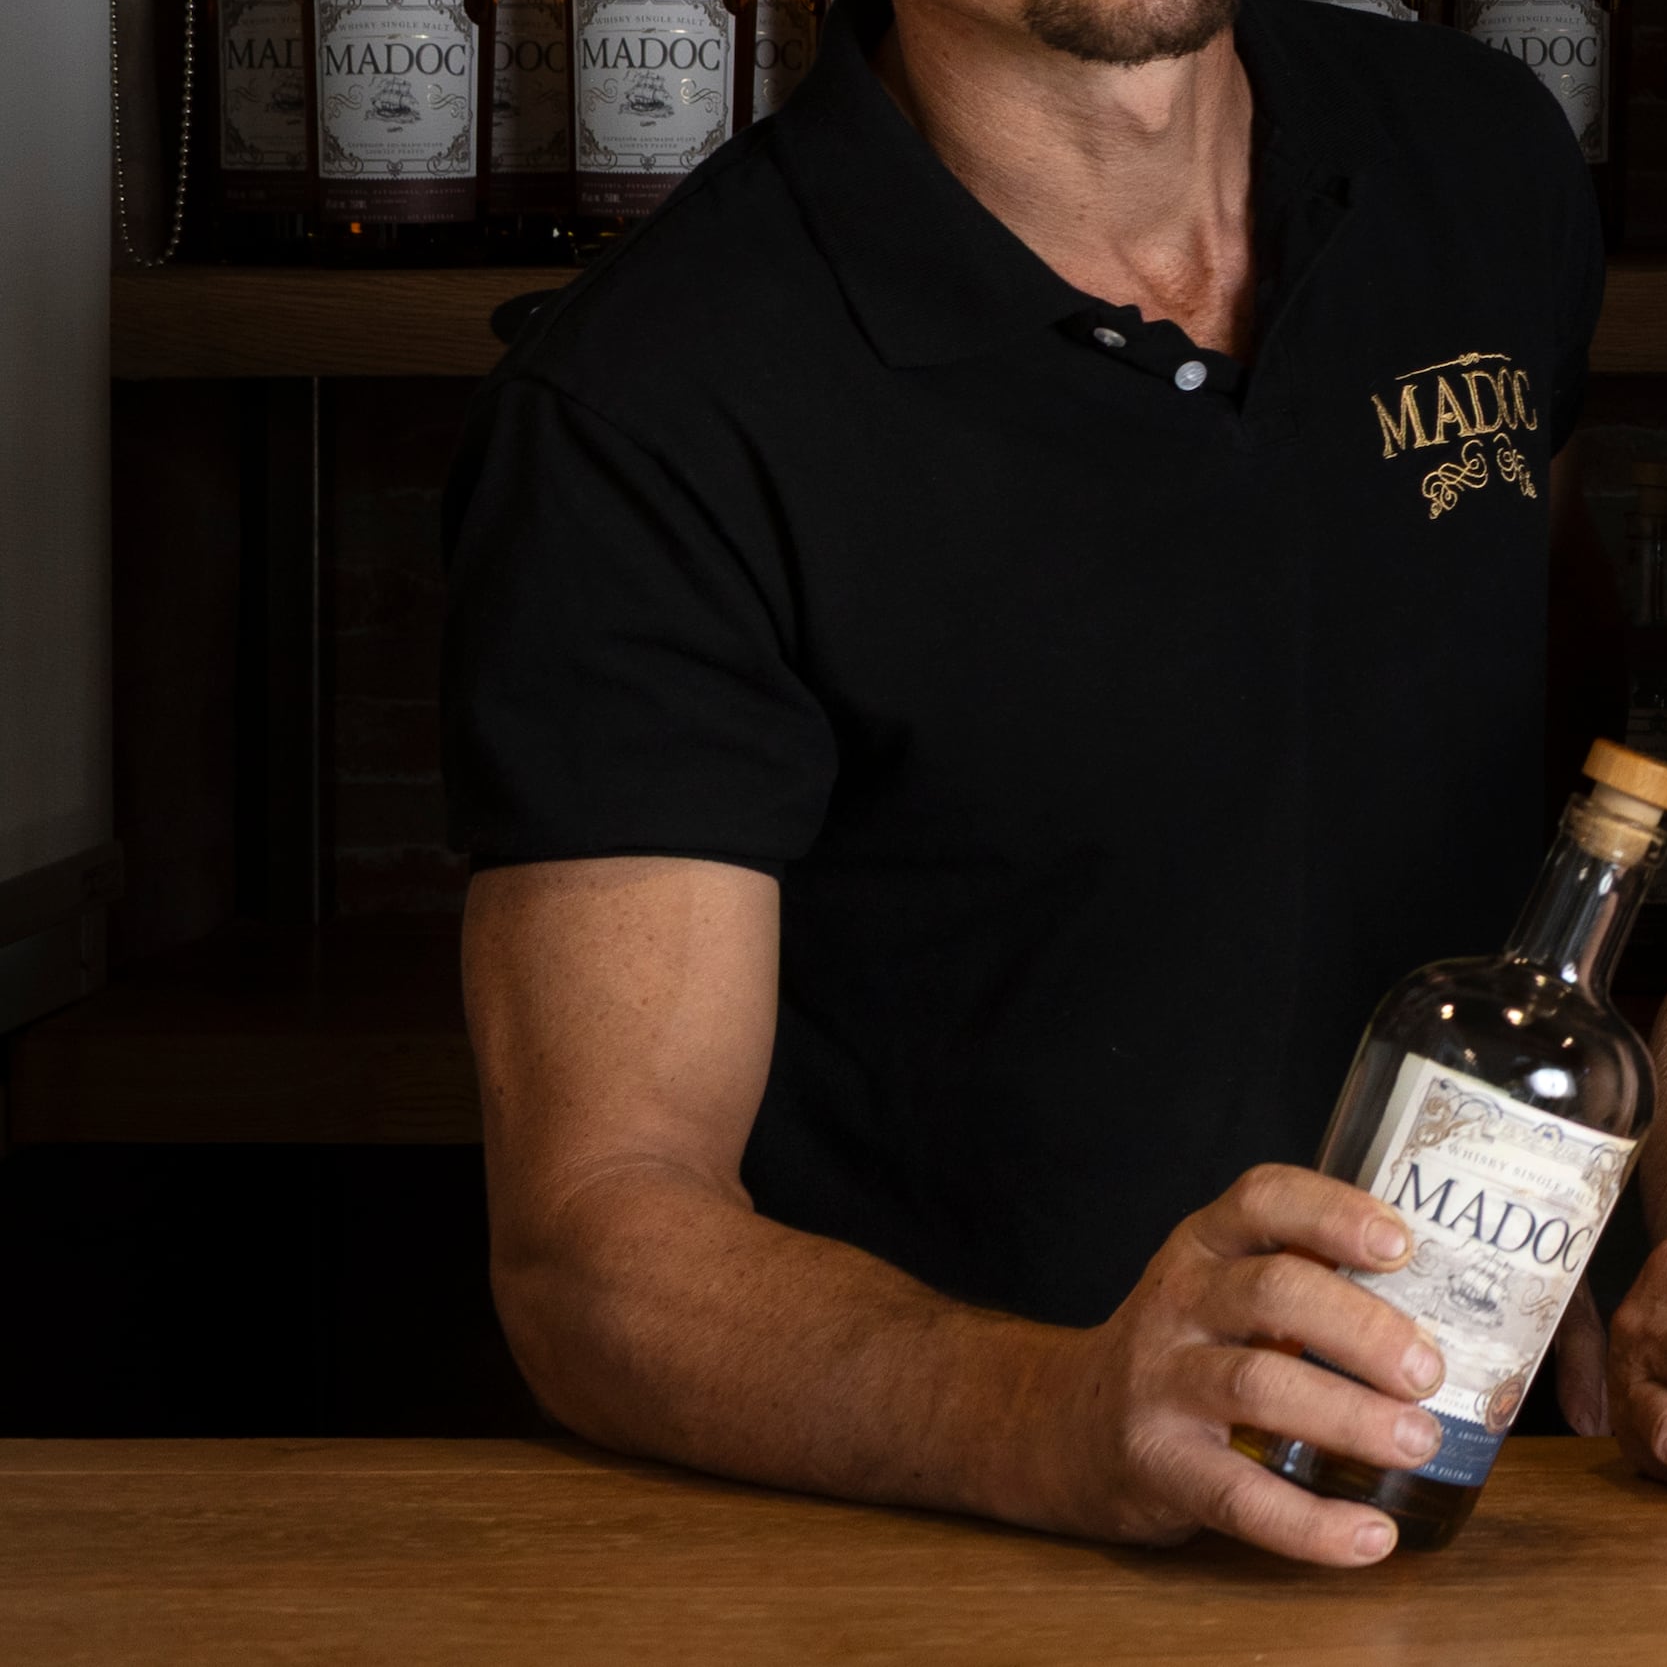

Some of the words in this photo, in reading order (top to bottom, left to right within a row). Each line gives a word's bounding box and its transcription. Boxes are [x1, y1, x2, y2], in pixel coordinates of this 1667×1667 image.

[338, 22, 376, 31] WHISKY
[381, 21, 420, 29] SINGLE
[423, 21, 449, 32] MALT
[594, 15, 631, 25] WHISKY
[635, 14, 672, 24] SINGLE
[676, 15, 705, 26] MALT
[325, 43, 466, 76] MADOC
[495, 40, 565, 73] DOC
[582, 37, 721, 71] MADOC
[1486, 36, 1597, 67] ADOC
[1448, 1143, 1510, 1171] WHISKY
[1514, 1166, 1561, 1192] SINGLE
[1392, 1162, 1593, 1273] MADOC
